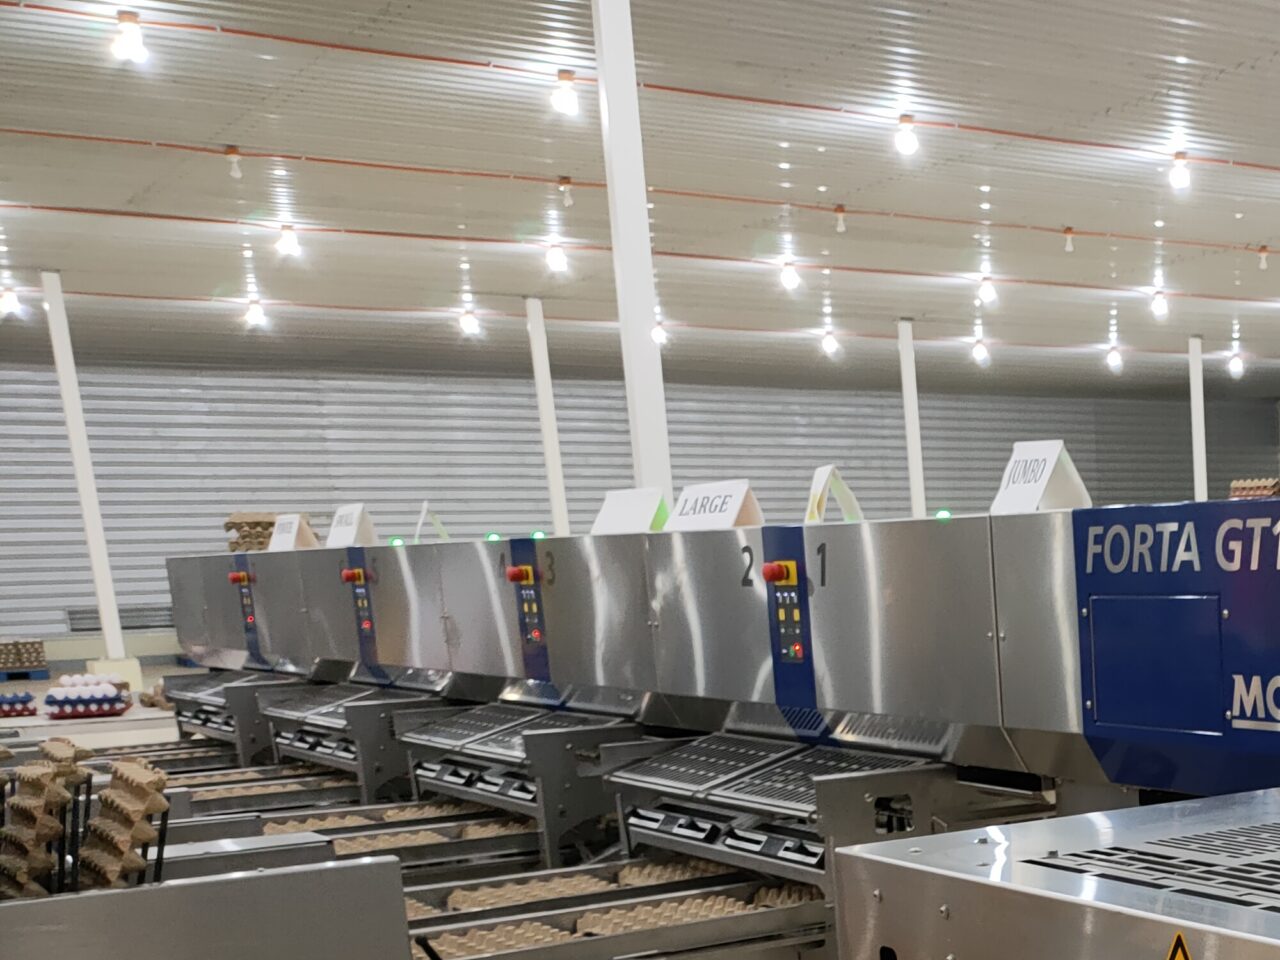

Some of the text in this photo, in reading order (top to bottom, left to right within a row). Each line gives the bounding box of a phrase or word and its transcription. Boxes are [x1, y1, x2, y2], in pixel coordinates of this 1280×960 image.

[1004, 457, 1047, 491] JUMBO
[678, 494, 733, 517] LARGE
[741, 545, 754, 587] 2
[816, 542, 827, 587] 1
[1085, 521, 1201, 574] FORTA
[545, 550, 556, 586] 3
